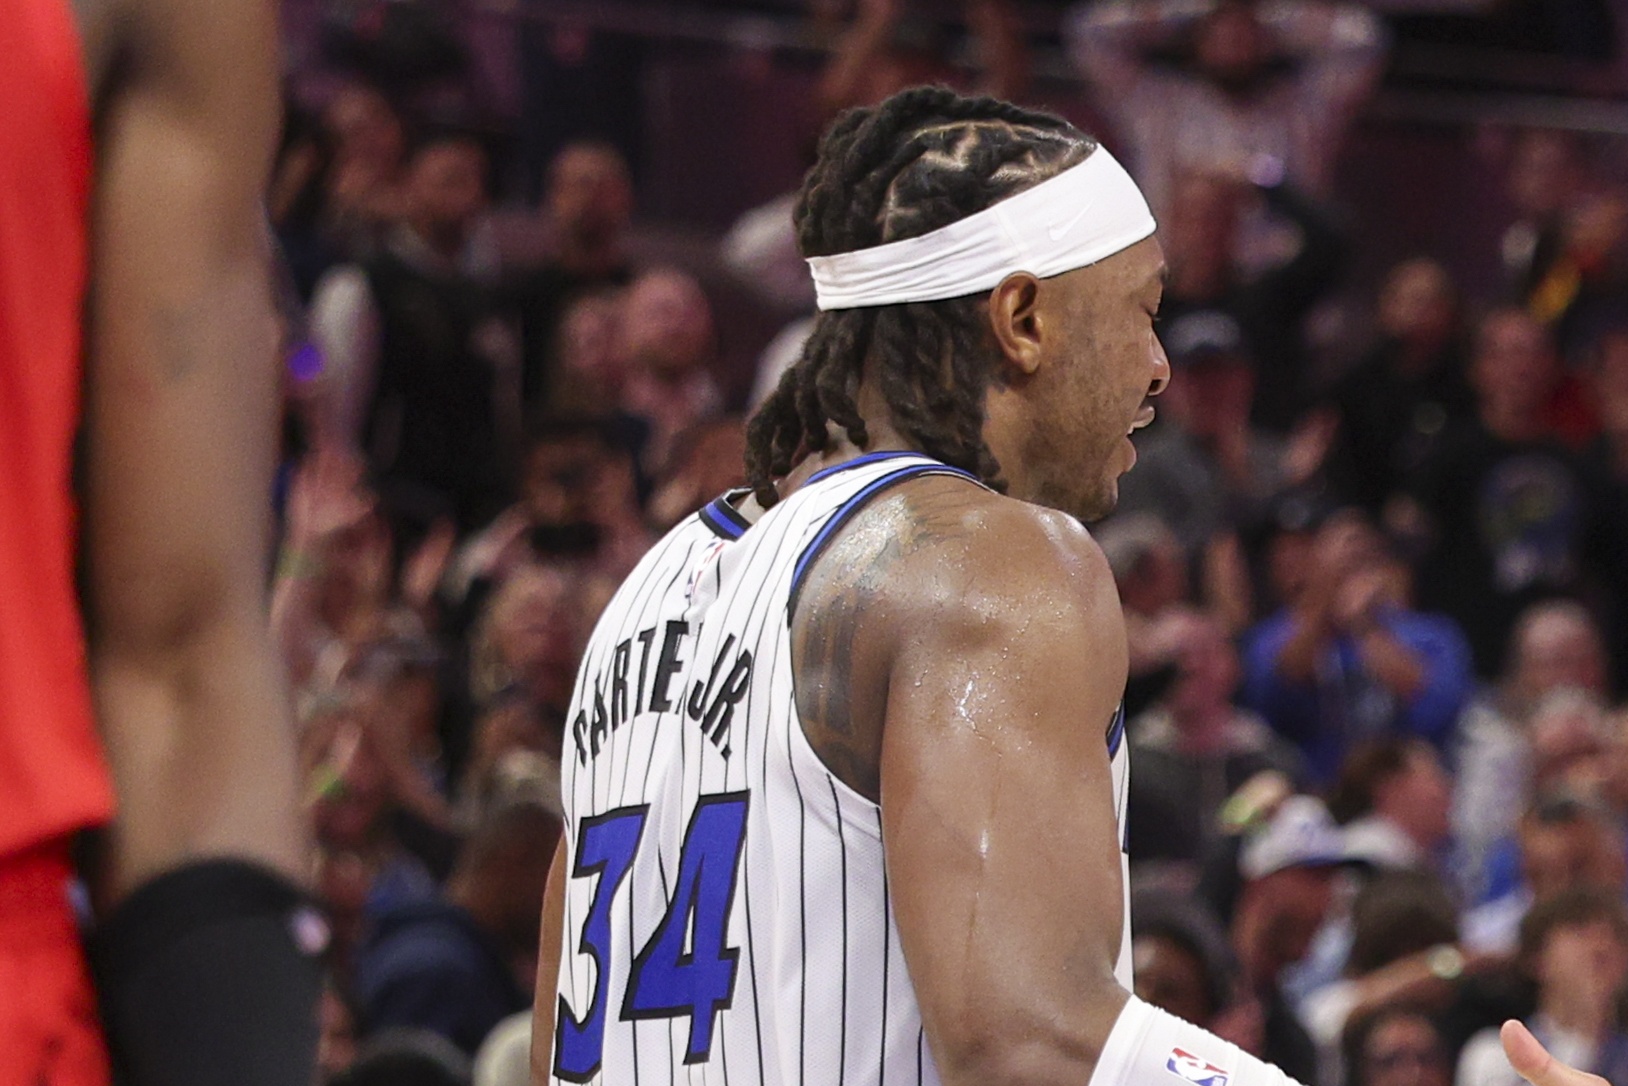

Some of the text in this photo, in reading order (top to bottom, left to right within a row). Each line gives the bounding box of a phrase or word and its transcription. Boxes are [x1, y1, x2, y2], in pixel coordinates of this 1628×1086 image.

[573, 619, 753, 768] CARTE JR.
[552, 789, 751, 1084] 34
